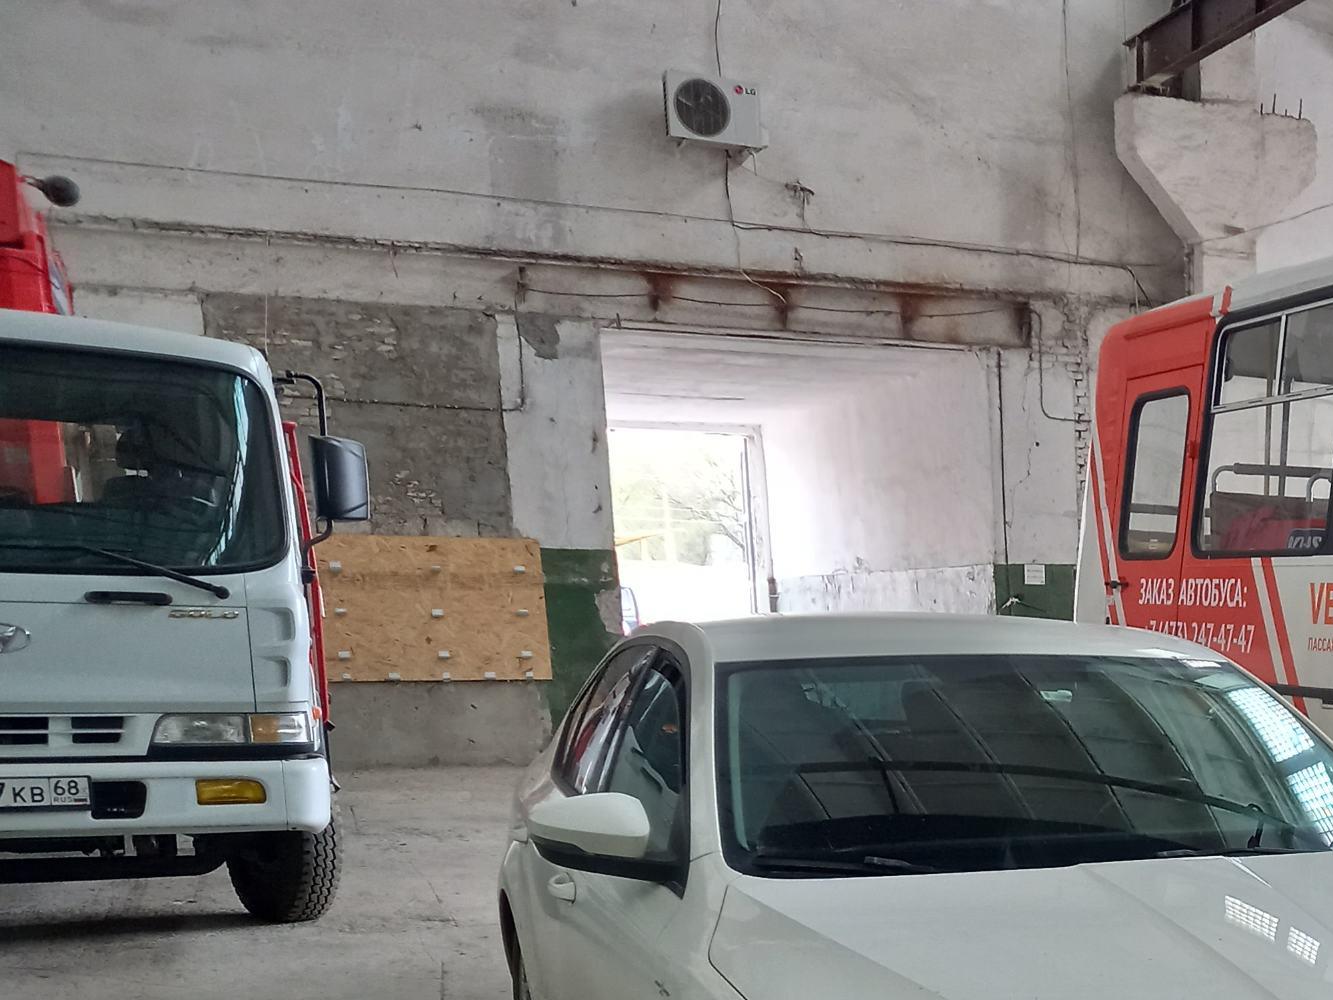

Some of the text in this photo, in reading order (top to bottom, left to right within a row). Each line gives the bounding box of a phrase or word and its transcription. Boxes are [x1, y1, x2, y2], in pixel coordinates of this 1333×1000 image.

[1139, 578, 1247, 607] ЗАКАЗ АВТОБУСА:
[1191, 622, 1255, 653] 247-47-47
[53, 780, 79, 796] 68
